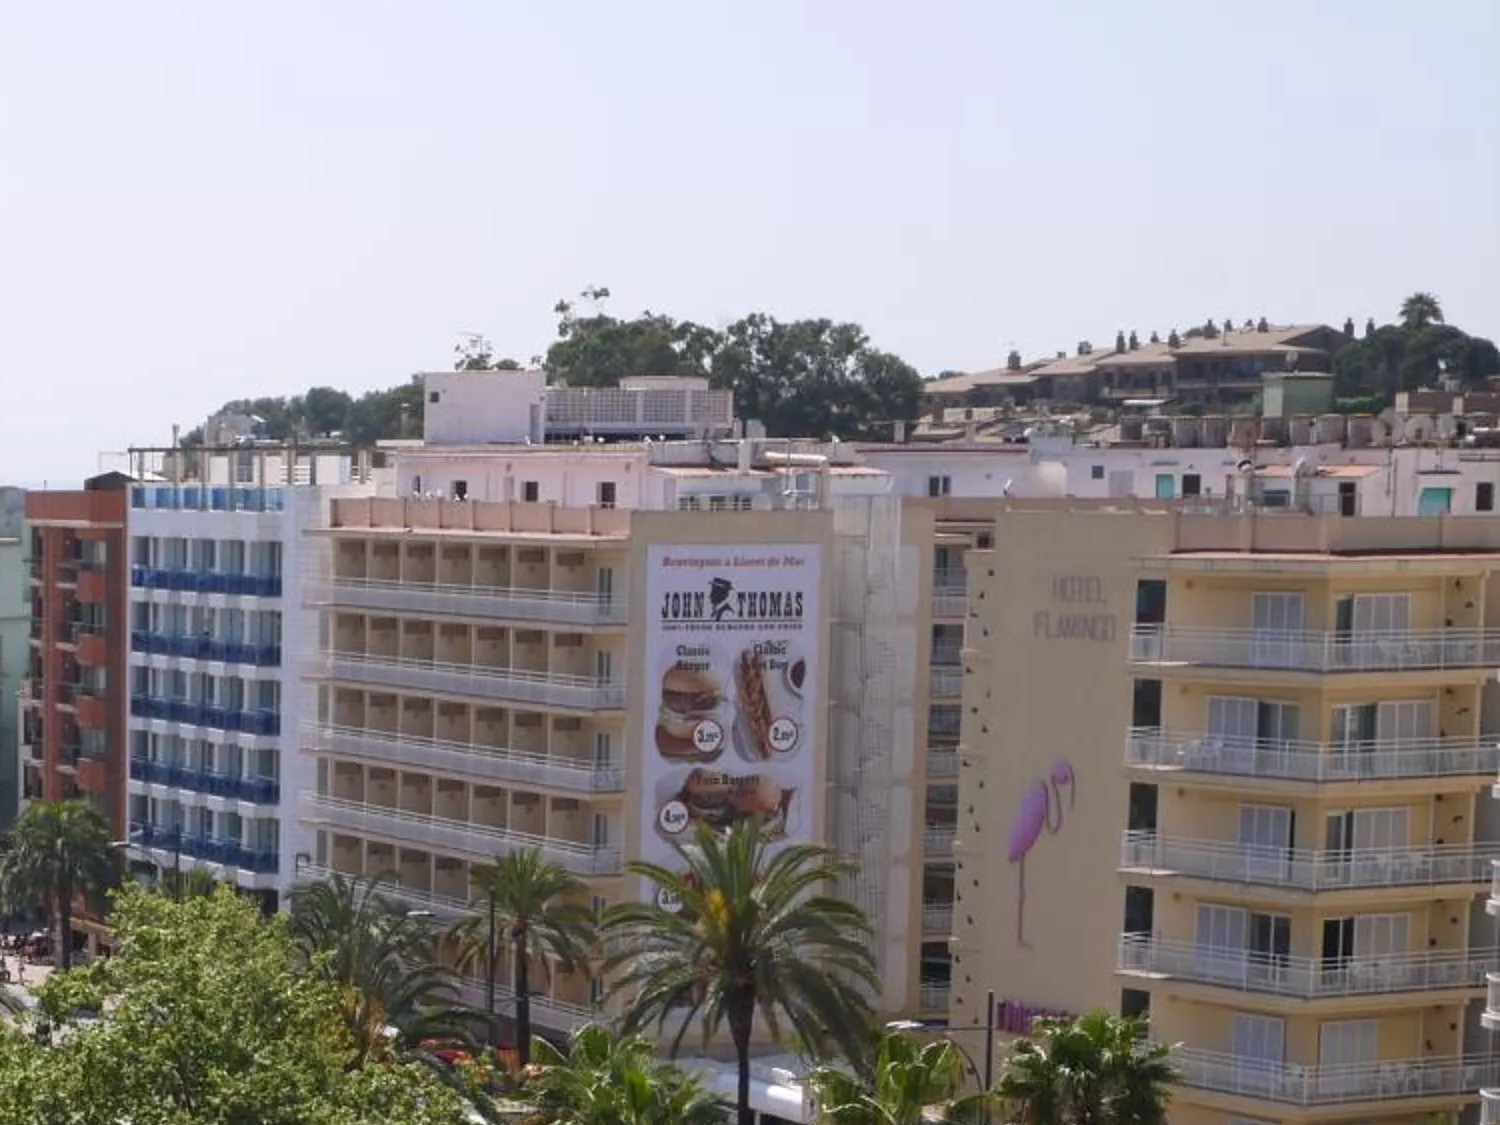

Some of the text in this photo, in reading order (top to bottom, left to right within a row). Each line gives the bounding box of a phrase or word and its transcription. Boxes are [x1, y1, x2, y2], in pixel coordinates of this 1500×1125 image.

[1049, 575, 1107, 604] HOTEL
[661, 592, 803, 619] JOHN THOMAS
[1033, 611, 1116, 642] FLAMINGO
[676, 645, 710, 657] Classic
